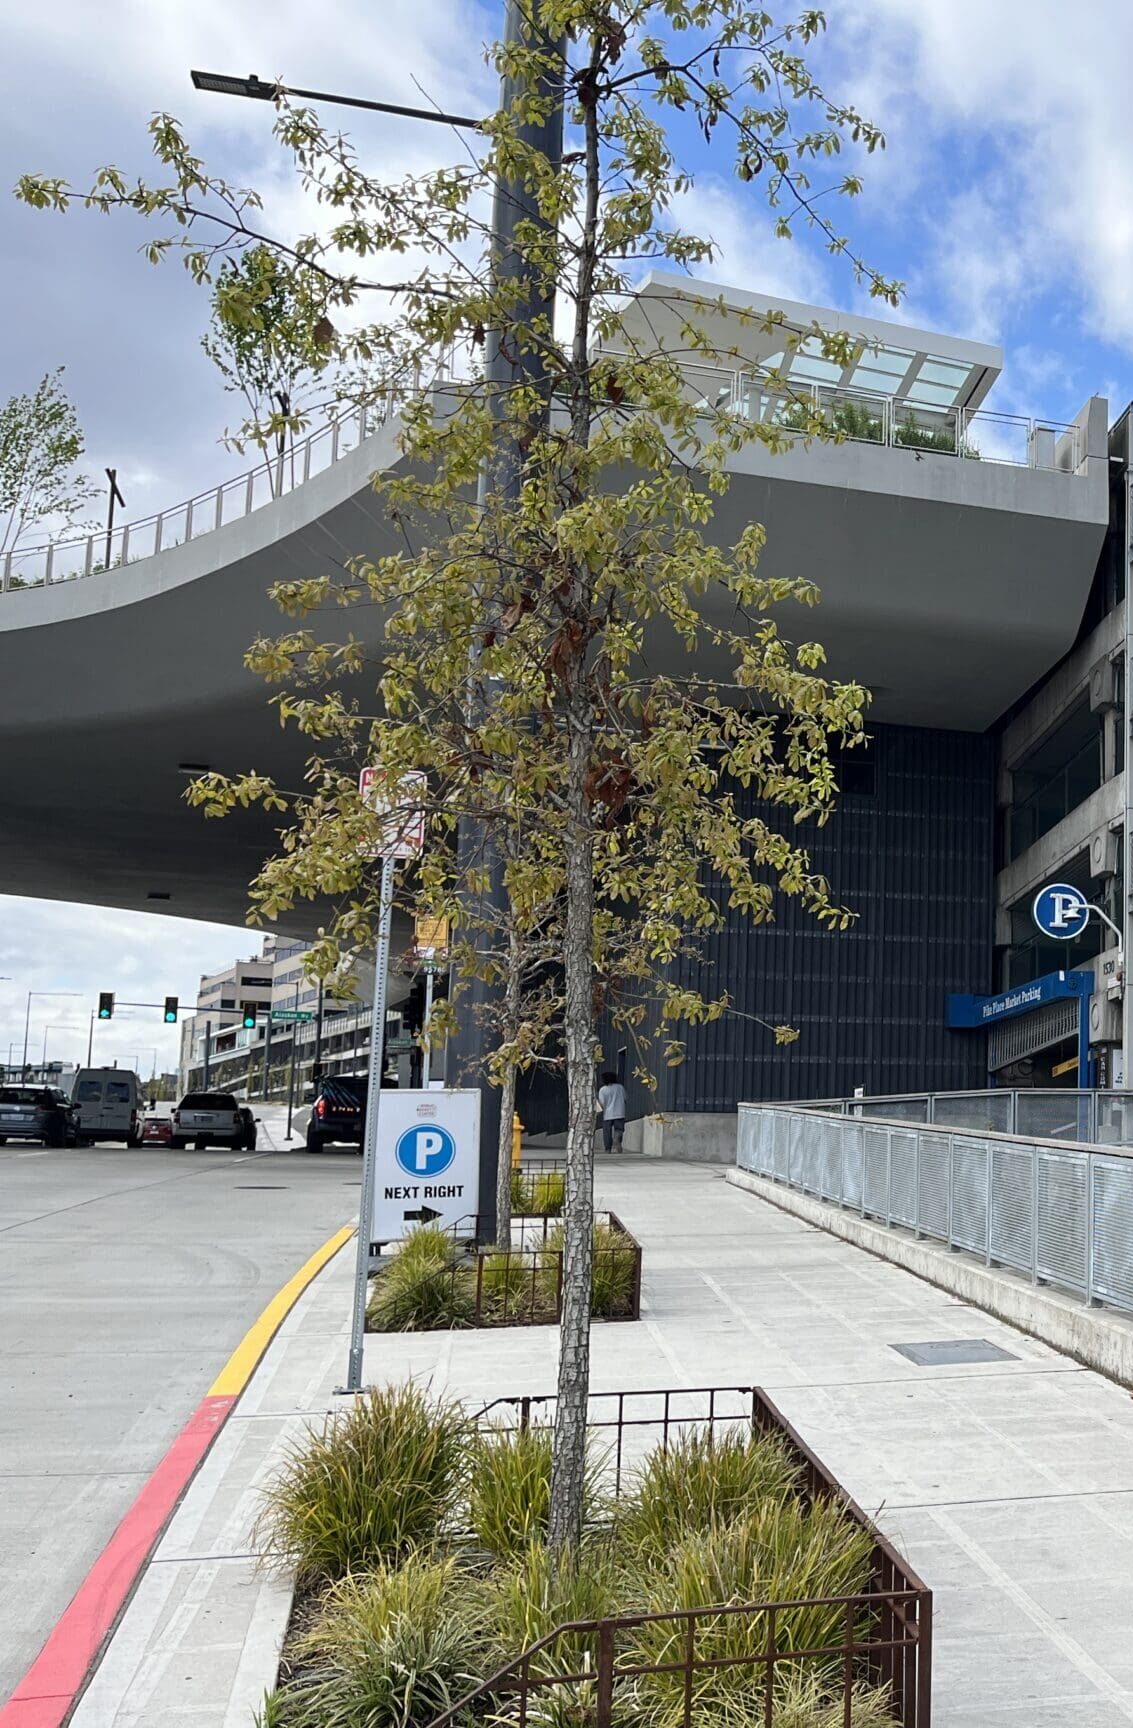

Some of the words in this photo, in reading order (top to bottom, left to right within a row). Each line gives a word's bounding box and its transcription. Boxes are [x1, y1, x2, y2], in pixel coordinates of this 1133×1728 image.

[1049, 892, 1081, 928] P
[1103, 960, 1115, 976] 1530
[982, 1004, 993, 1018] Pike
[992, 1000, 1005, 1015] Place
[1004, 994, 1021, 1010] Market
[1021, 985, 1042, 1003] Parking
[415, 1131, 443, 1170] P
[384, 1186, 420, 1200] NEXT
[424, 1185, 464, 1198] RIGHT
